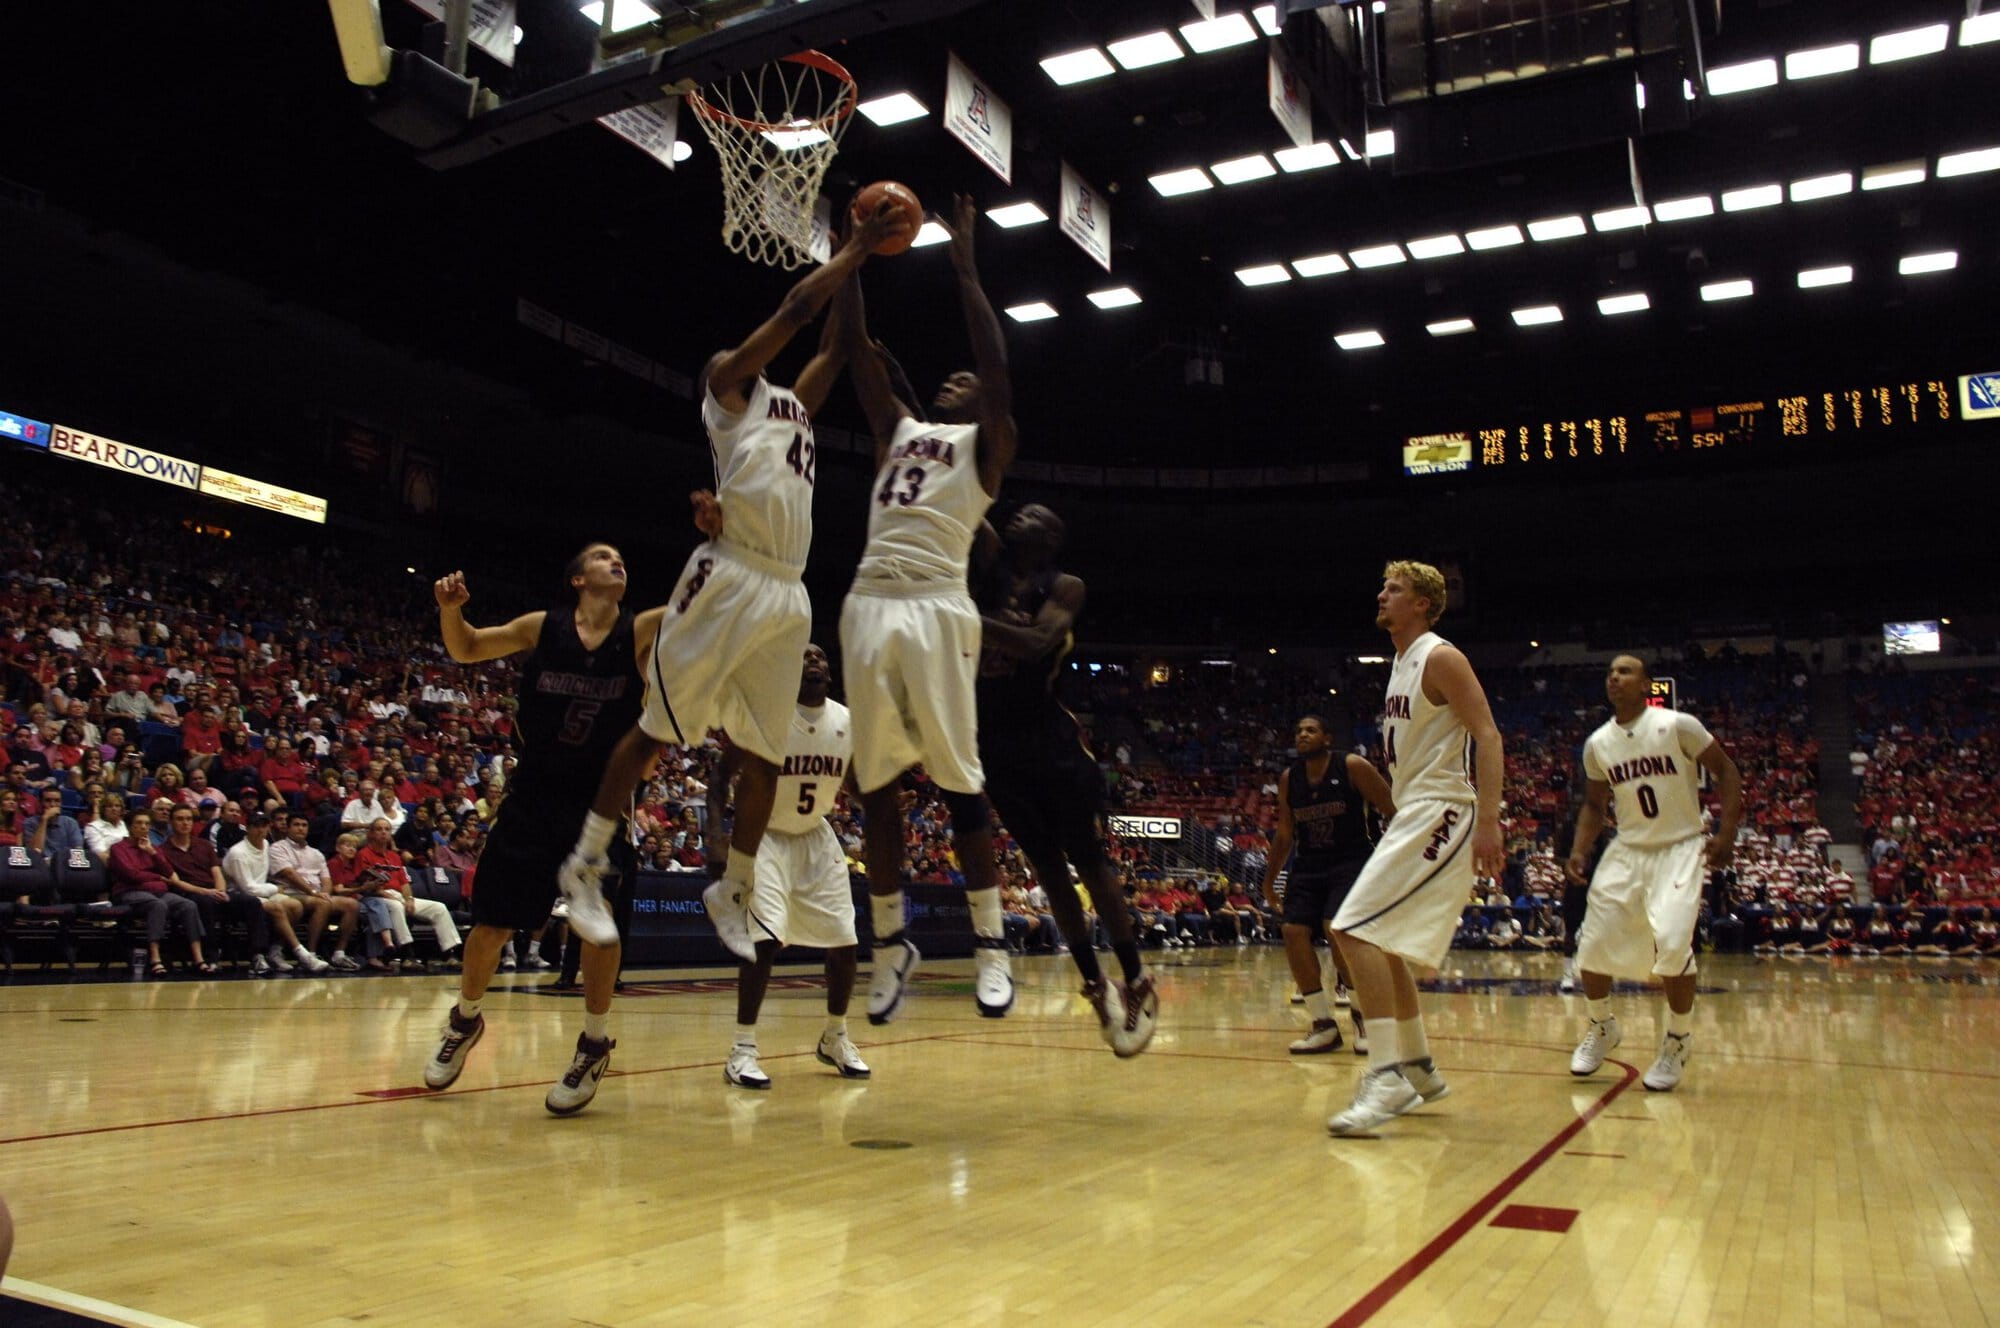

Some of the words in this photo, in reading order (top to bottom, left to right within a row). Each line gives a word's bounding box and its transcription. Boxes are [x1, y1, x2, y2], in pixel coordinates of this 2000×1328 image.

[53, 428, 127, 468] BEAR
[124, 448, 198, 487] DOWN
[786, 432, 815, 487] 42
[1409, 461, 1468, 475] WATSON
[878, 464, 926, 507] 43
[557, 698, 605, 747] 5
[1608, 753, 1679, 787] ARIZONA
[796, 782, 818, 816] 5
[1635, 782, 1661, 820] 0
[1111, 820, 1180, 835] GEICO
[1422, 809, 1459, 862] CATS
